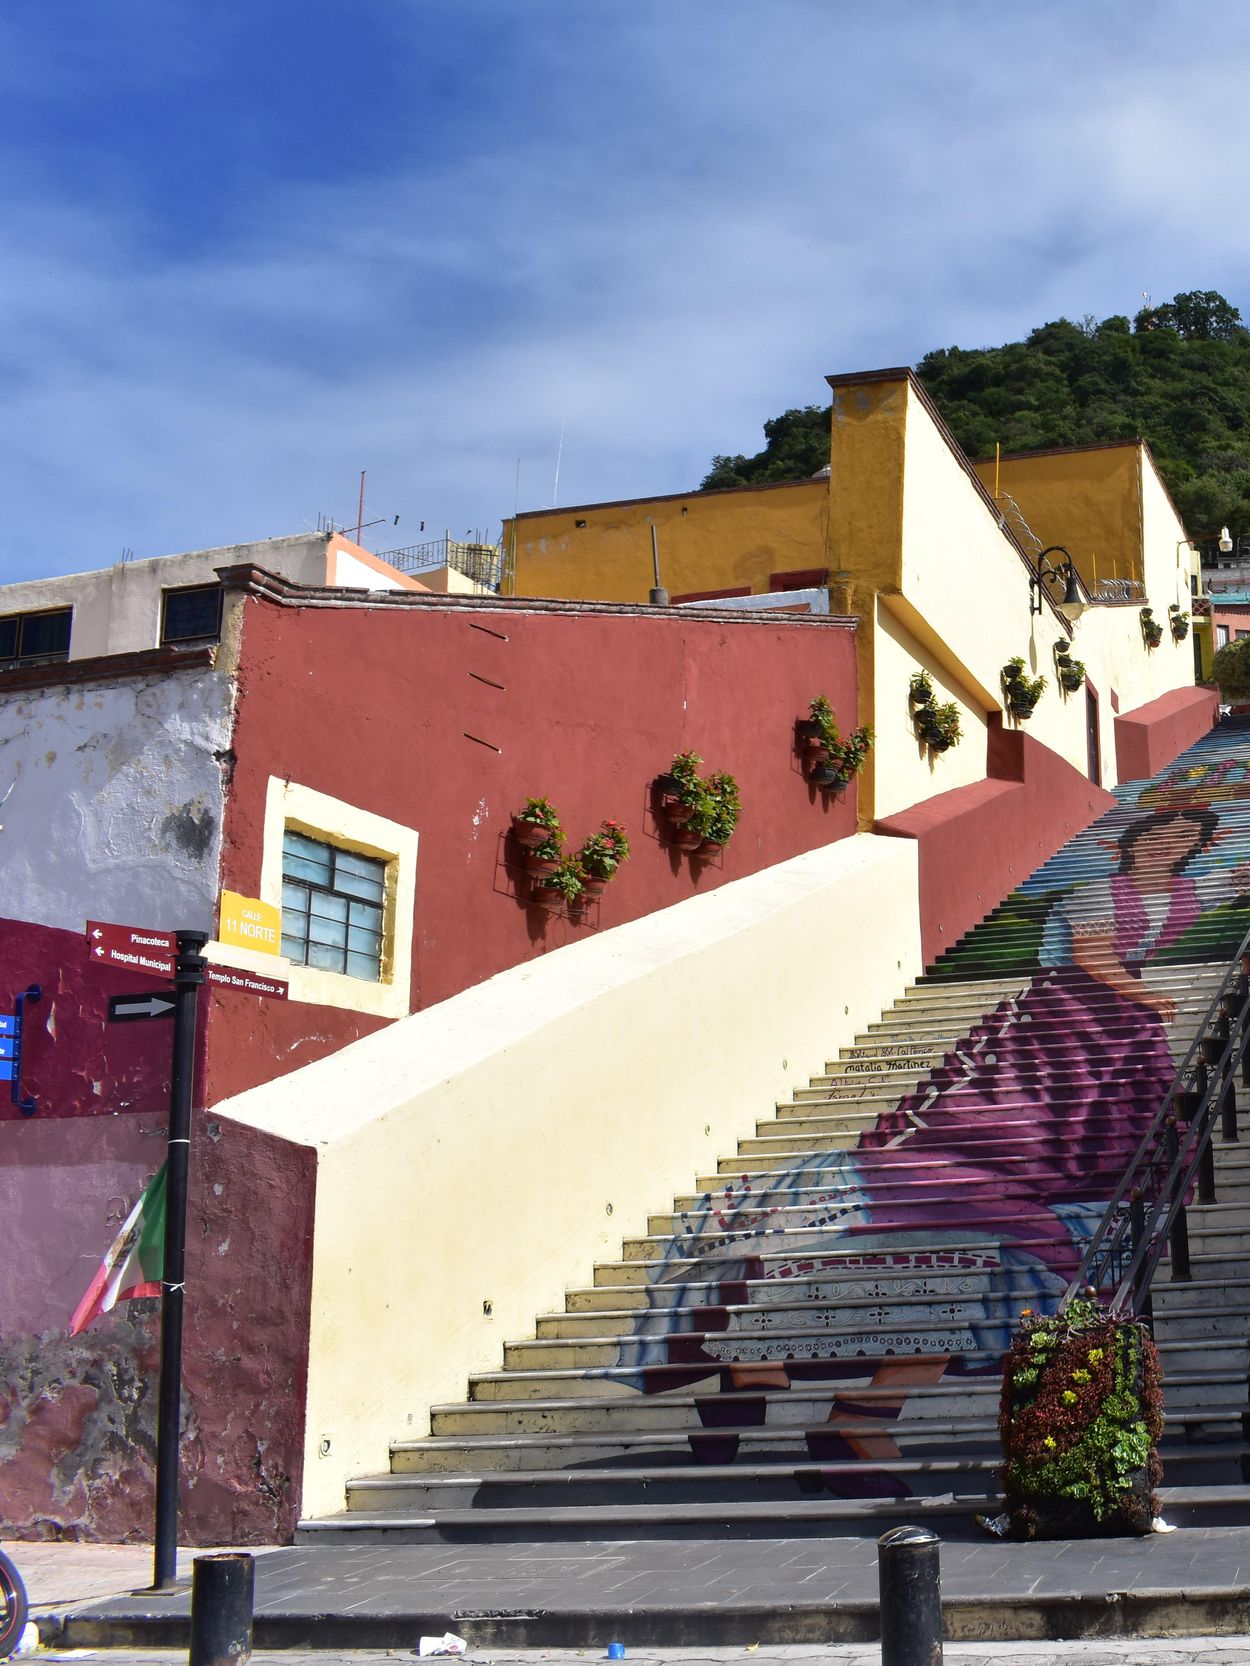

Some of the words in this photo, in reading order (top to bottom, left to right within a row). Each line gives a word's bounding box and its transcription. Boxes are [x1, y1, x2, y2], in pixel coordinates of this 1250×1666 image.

[242, 909, 263, 922] CALLE
[131, 933, 170, 947] Pinacoteca
[226, 918, 237, 933] 11
[240, 921, 276, 943] NORTE
[110, 949, 139, 964] Hospital
[139, 956, 171, 972] Municipal
[208, 970, 231, 984] Templo
[231, 975, 244, 986] San
[244, 978, 275, 993] Francisco
